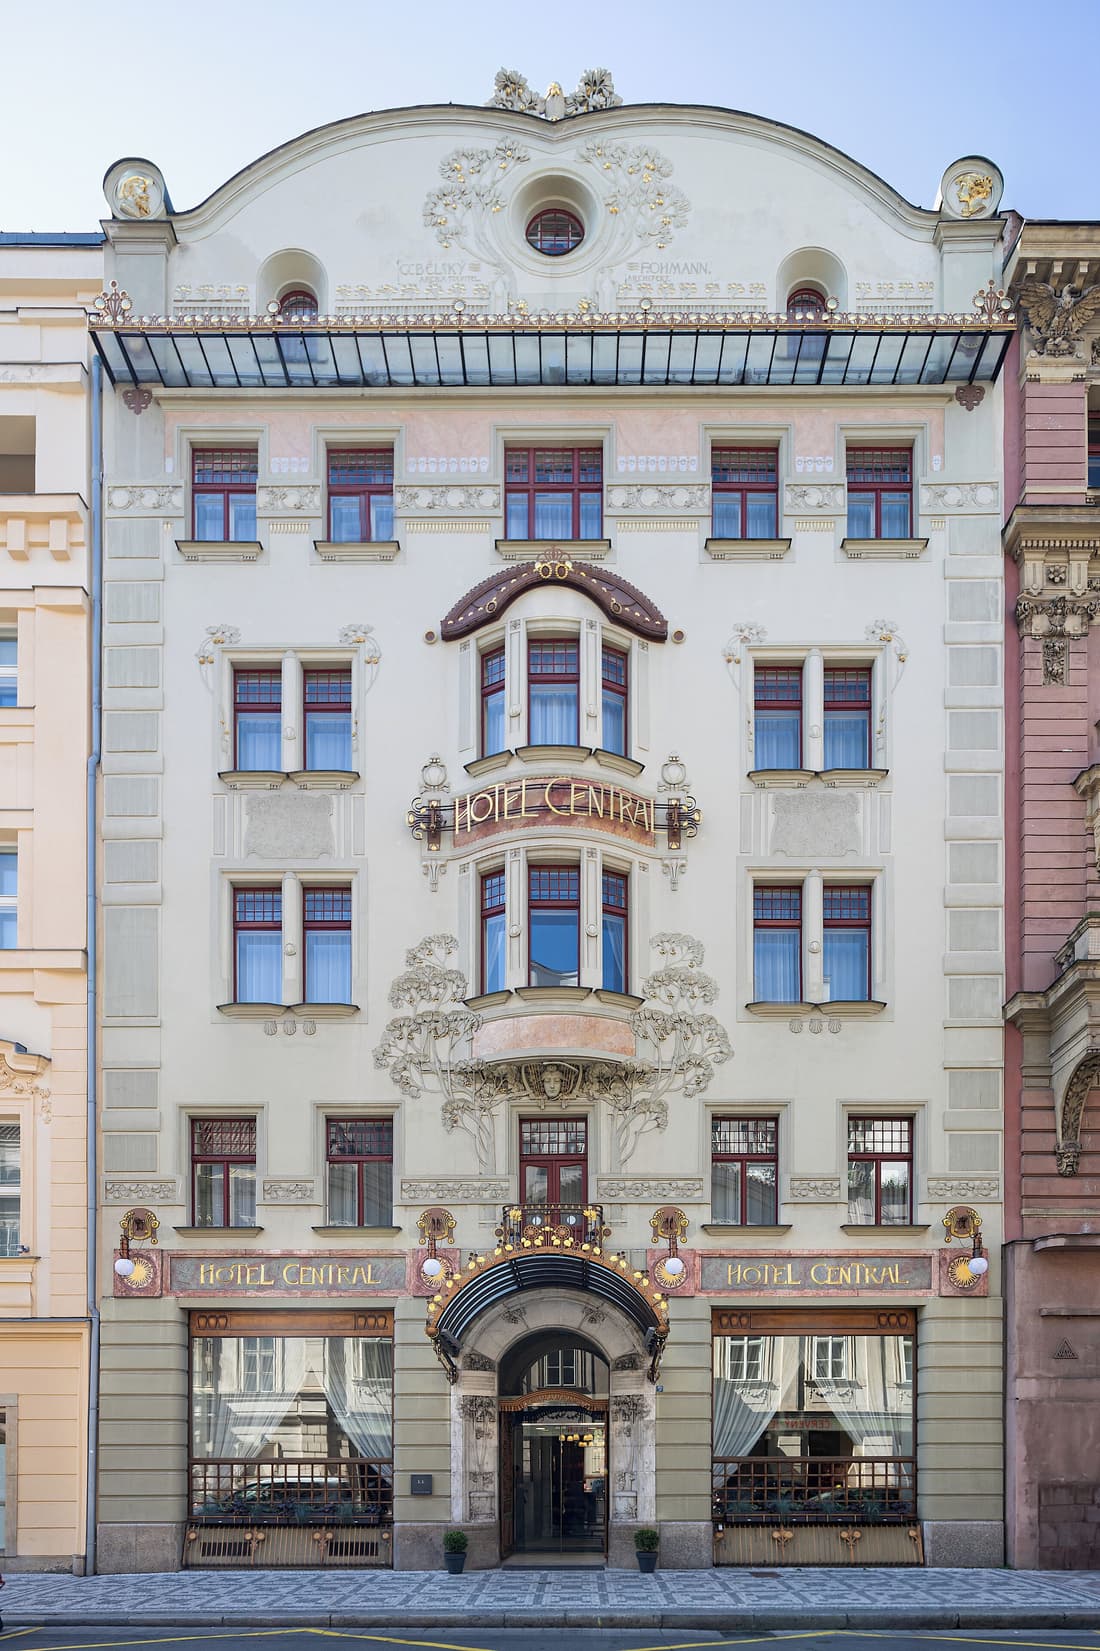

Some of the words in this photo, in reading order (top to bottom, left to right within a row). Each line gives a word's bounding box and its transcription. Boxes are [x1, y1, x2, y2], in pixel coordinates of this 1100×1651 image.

[455, 779, 539, 834] HOTEL
[544, 777, 668, 834] CENTRAL
[199, 1263, 275, 1286] HOTEL
[282, 1263, 382, 1286] CENTRAL
[727, 1263, 802, 1286] HOTEL
[810, 1262, 909, 1286] CENTRAL
